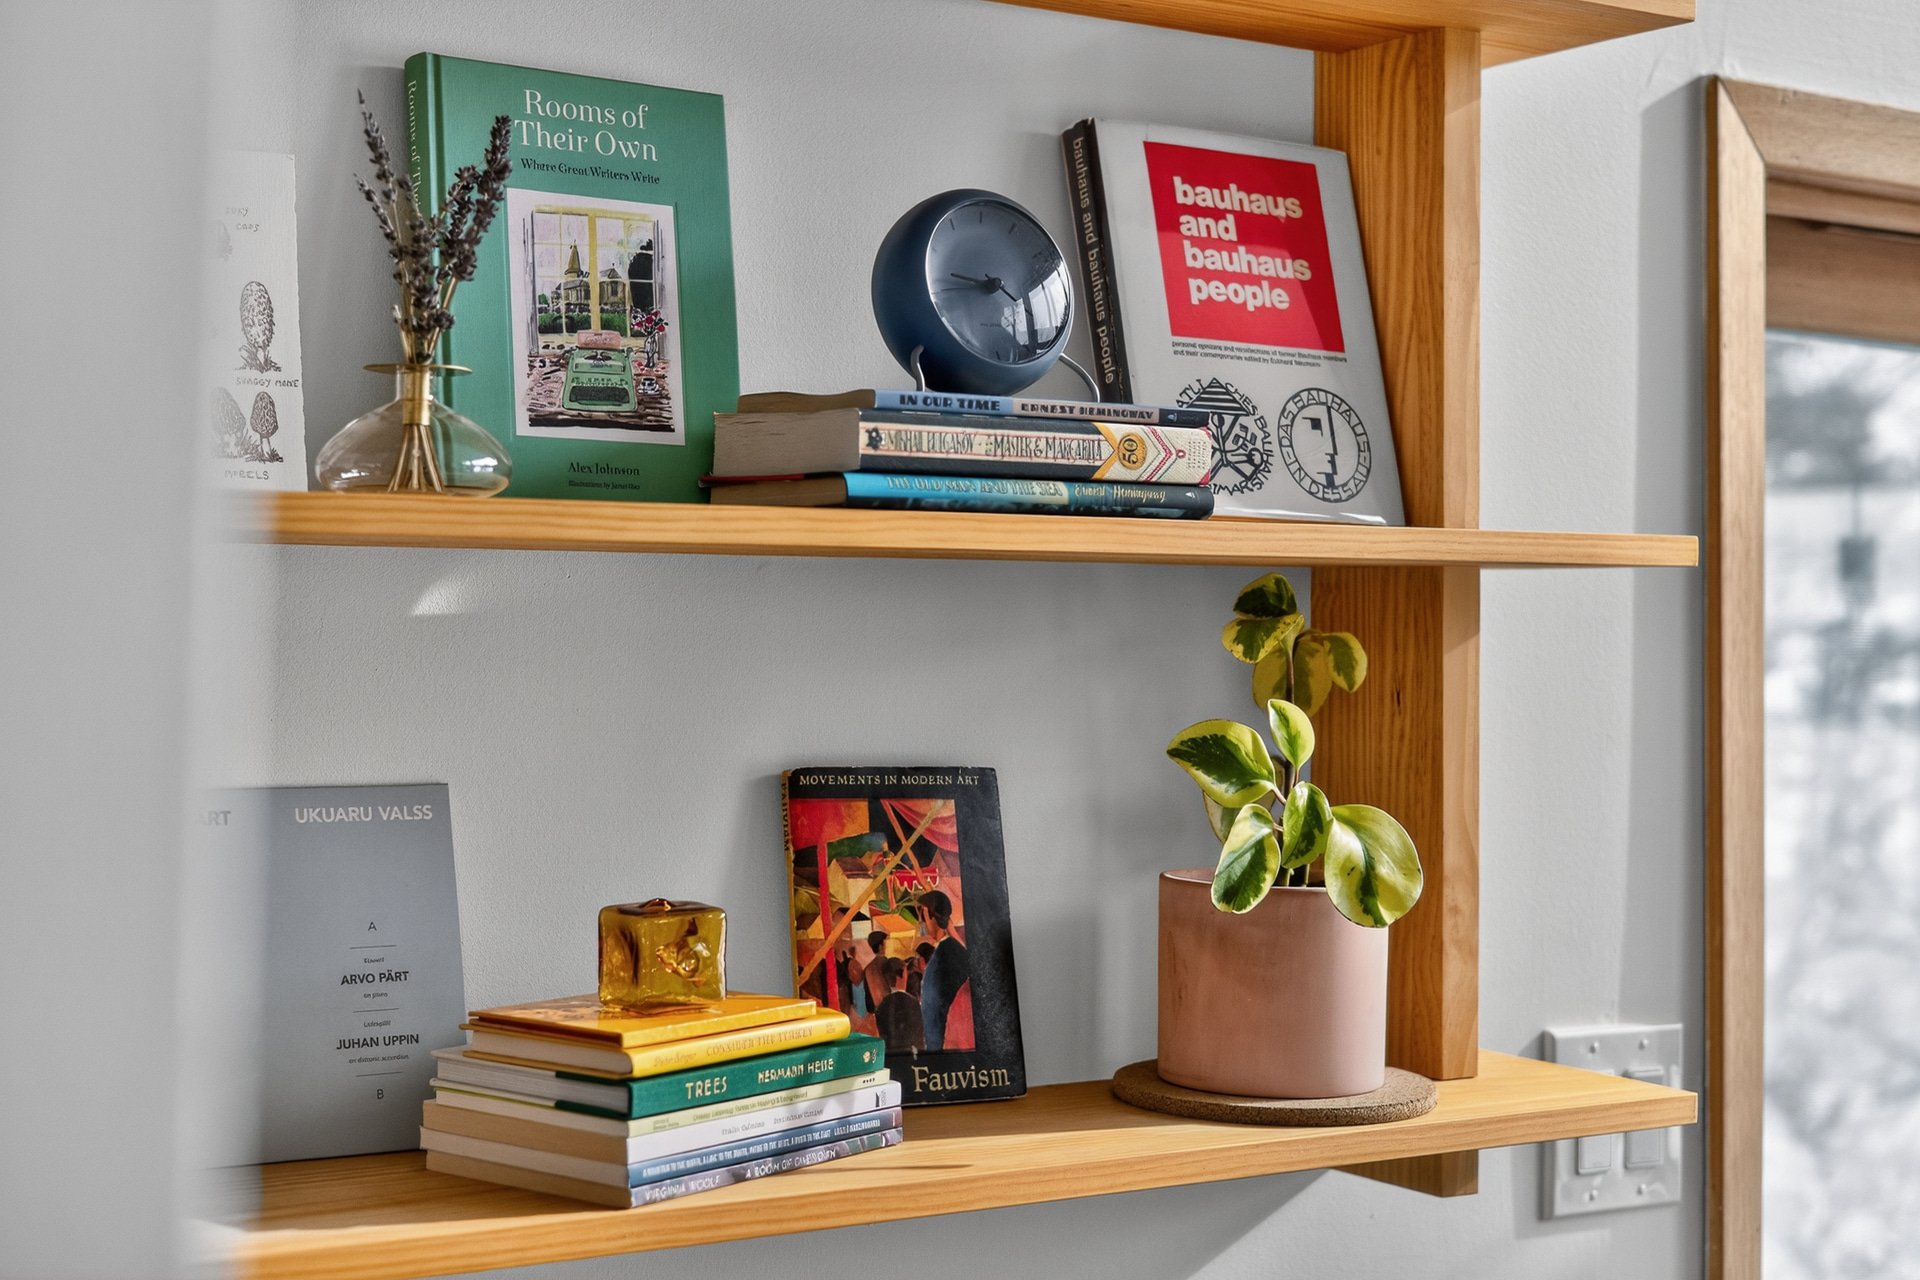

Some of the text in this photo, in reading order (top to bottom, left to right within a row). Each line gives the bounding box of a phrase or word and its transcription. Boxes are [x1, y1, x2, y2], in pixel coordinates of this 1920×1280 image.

[408, 80, 417, 141] Rooms
[524, 89, 648, 129] Rooms of
[411, 145, 421, 161] of
[514, 120, 658, 162] Their Own
[521, 158, 660, 184] Where Great Writers Write
[1173, 176, 1303, 219] bauhaus
[1179, 213, 1238, 242] and
[1073, 136, 1115, 384] bauhaus and bauhaus people
[1183, 240, 1312, 281] bauhaus
[1188, 278, 1290, 312] people
[900, 394, 1153, 419] IN OUR TIME ERNEST HEMINGWAY
[1280, 408, 1295, 448] DAS
[993, 434, 1033, 459] MASTER
[568, 462, 640, 476] Alex Johnson
[888, 477, 911, 490] THE
[914, 478, 942, 491] OLD
[945, 480, 977, 493] MAN
[981, 481, 1007, 494] AND
[1010, 481, 1037, 495] THE
[1038, 481, 1064, 497] SEA
[1113, 485, 1166, 502] Hemingway
[800, 774, 980, 786] MOVEMENTS IN MODERN ART
[295, 804, 433, 824] UKUARU VALSS
[367, 921, 377, 931] A
[340, 969, 409, 986] ARVO PÄRT
[336, 1033, 419, 1050] JUHAN UPPIN
[685, 1058, 834, 1100] TREES HERMANN HESSE
[912, 1065, 1010, 1093] Fauvism
[377, 1088, 384, 1100] B
[645, 1183, 686, 1201] VIRGINIA
[688, 1175, 720, 1193] WOOLF
[745, 1168, 751, 1179] A
[754, 1160, 779, 1176] ROOM
[781, 1158, 793, 1169] OF
